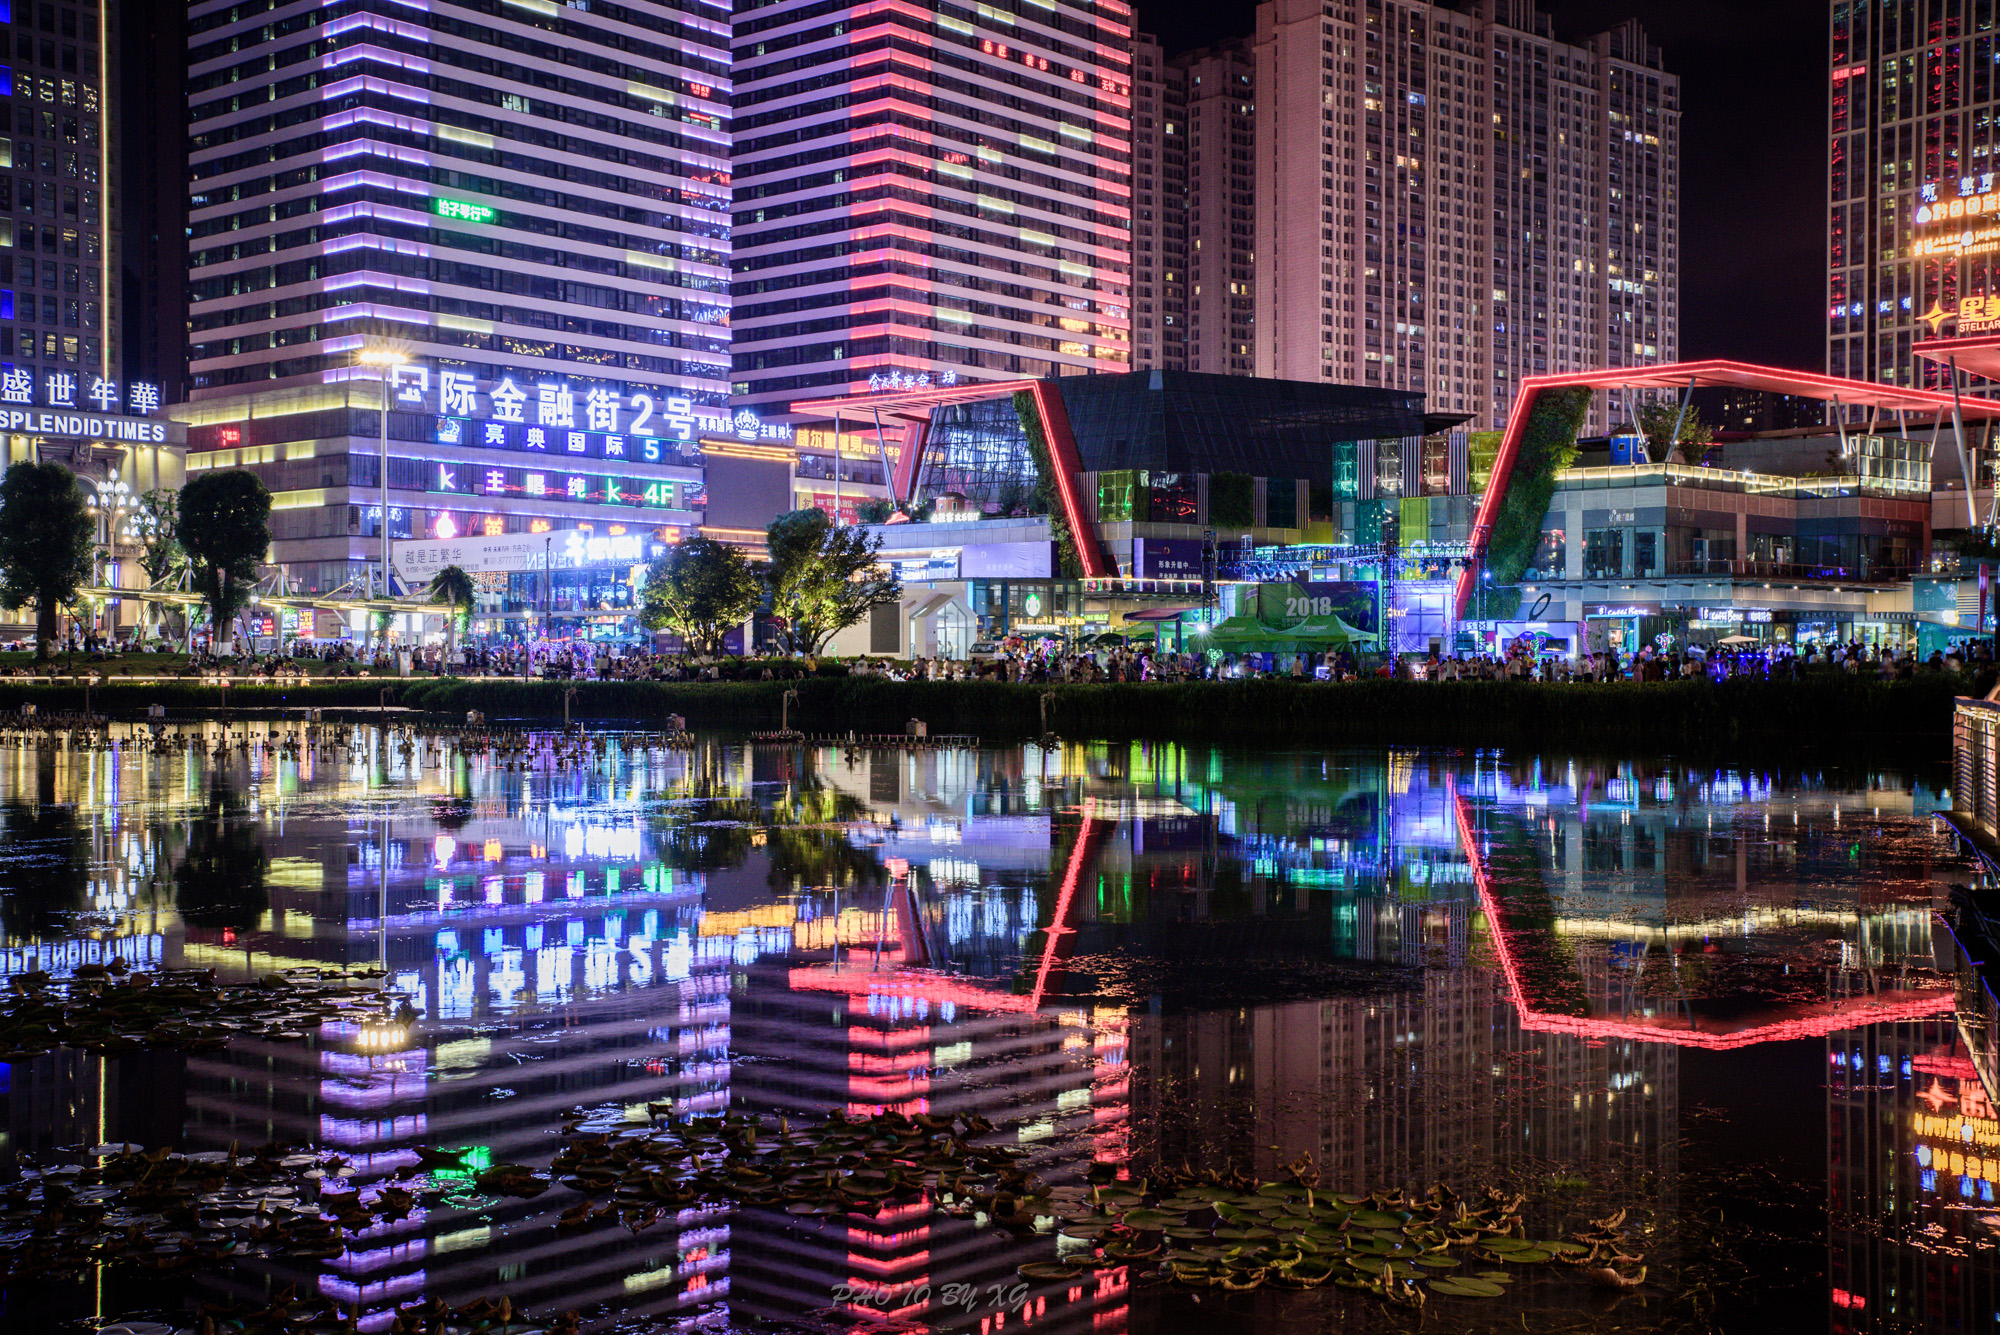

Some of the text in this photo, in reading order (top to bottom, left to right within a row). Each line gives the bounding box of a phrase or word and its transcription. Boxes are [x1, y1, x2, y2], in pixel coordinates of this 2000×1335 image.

[983, 39, 1048, 71] 品匠装修
[1932, 192, 2000, 221] 黔团团旅
[1959, 320, 2000, 333] STELLAR
[1, 368, 159, 414] 盛世年華
[391, 363, 696, 440] 国际金融街2号
[698, 416, 734, 433] 亮典国际
[485, 423, 624, 456] 亮典国际
[644, 483, 674, 504] 4F
[405, 547, 462, 564] 越是正繁华
[1285, 596, 1332, 617] 2018
[1017, 623, 1045, 631] STARBUCKS
